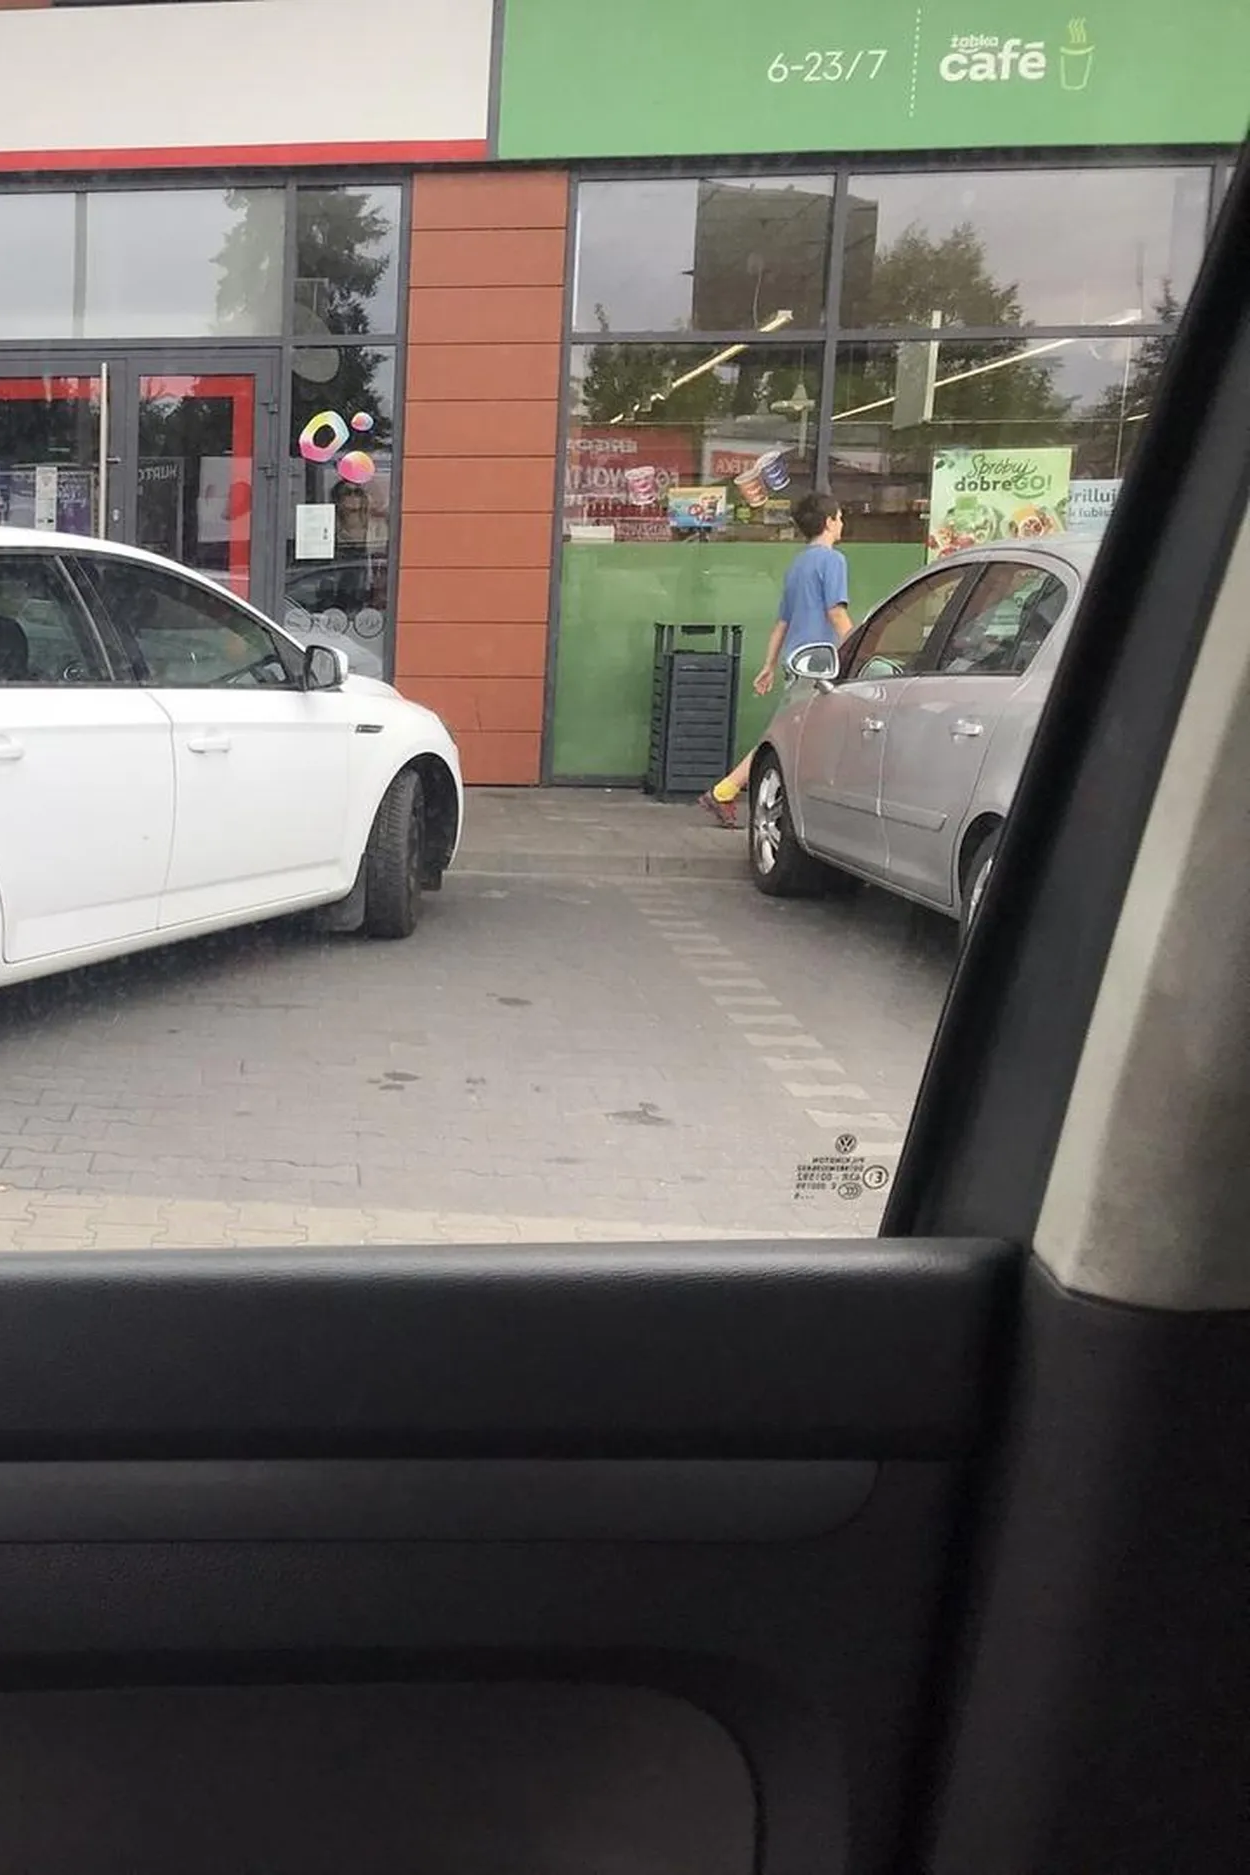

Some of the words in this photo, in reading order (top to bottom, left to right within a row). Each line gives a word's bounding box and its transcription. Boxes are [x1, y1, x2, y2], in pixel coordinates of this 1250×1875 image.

[767, 49, 888, 83] 6-23/7
[939, 38, 1047, 81] café
[967, 454, 1038, 480] Spróbuj
